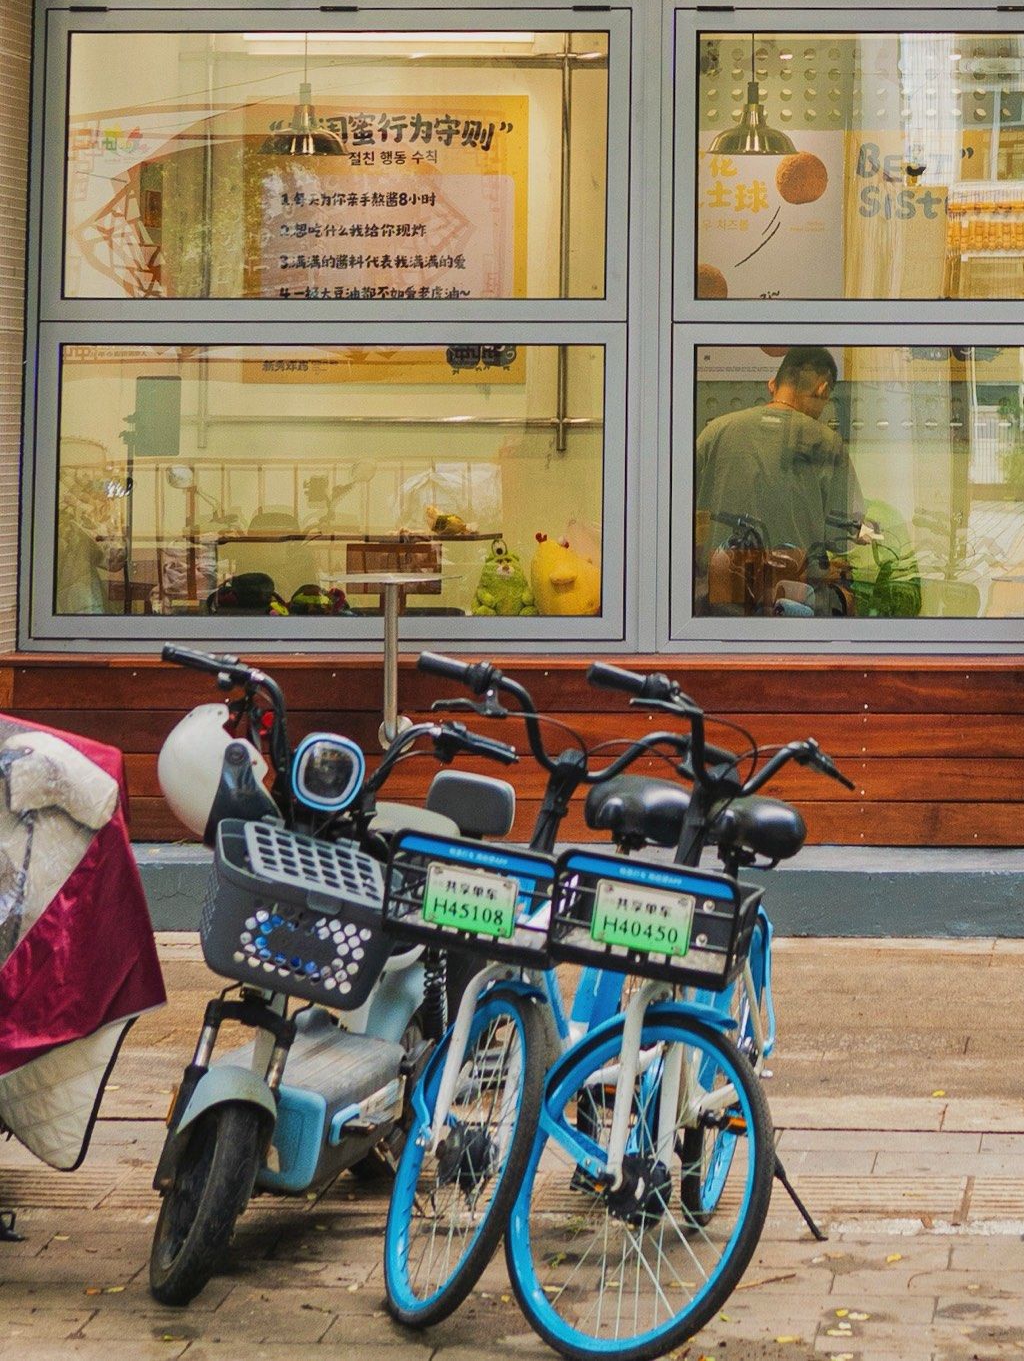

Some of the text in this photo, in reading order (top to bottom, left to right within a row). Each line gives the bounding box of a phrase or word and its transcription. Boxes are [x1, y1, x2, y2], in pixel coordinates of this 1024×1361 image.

[348, 149, 439, 166] 절친 행동 수칙
[432, 896, 504, 926] H45108
[602, 915, 679, 944] H40450
